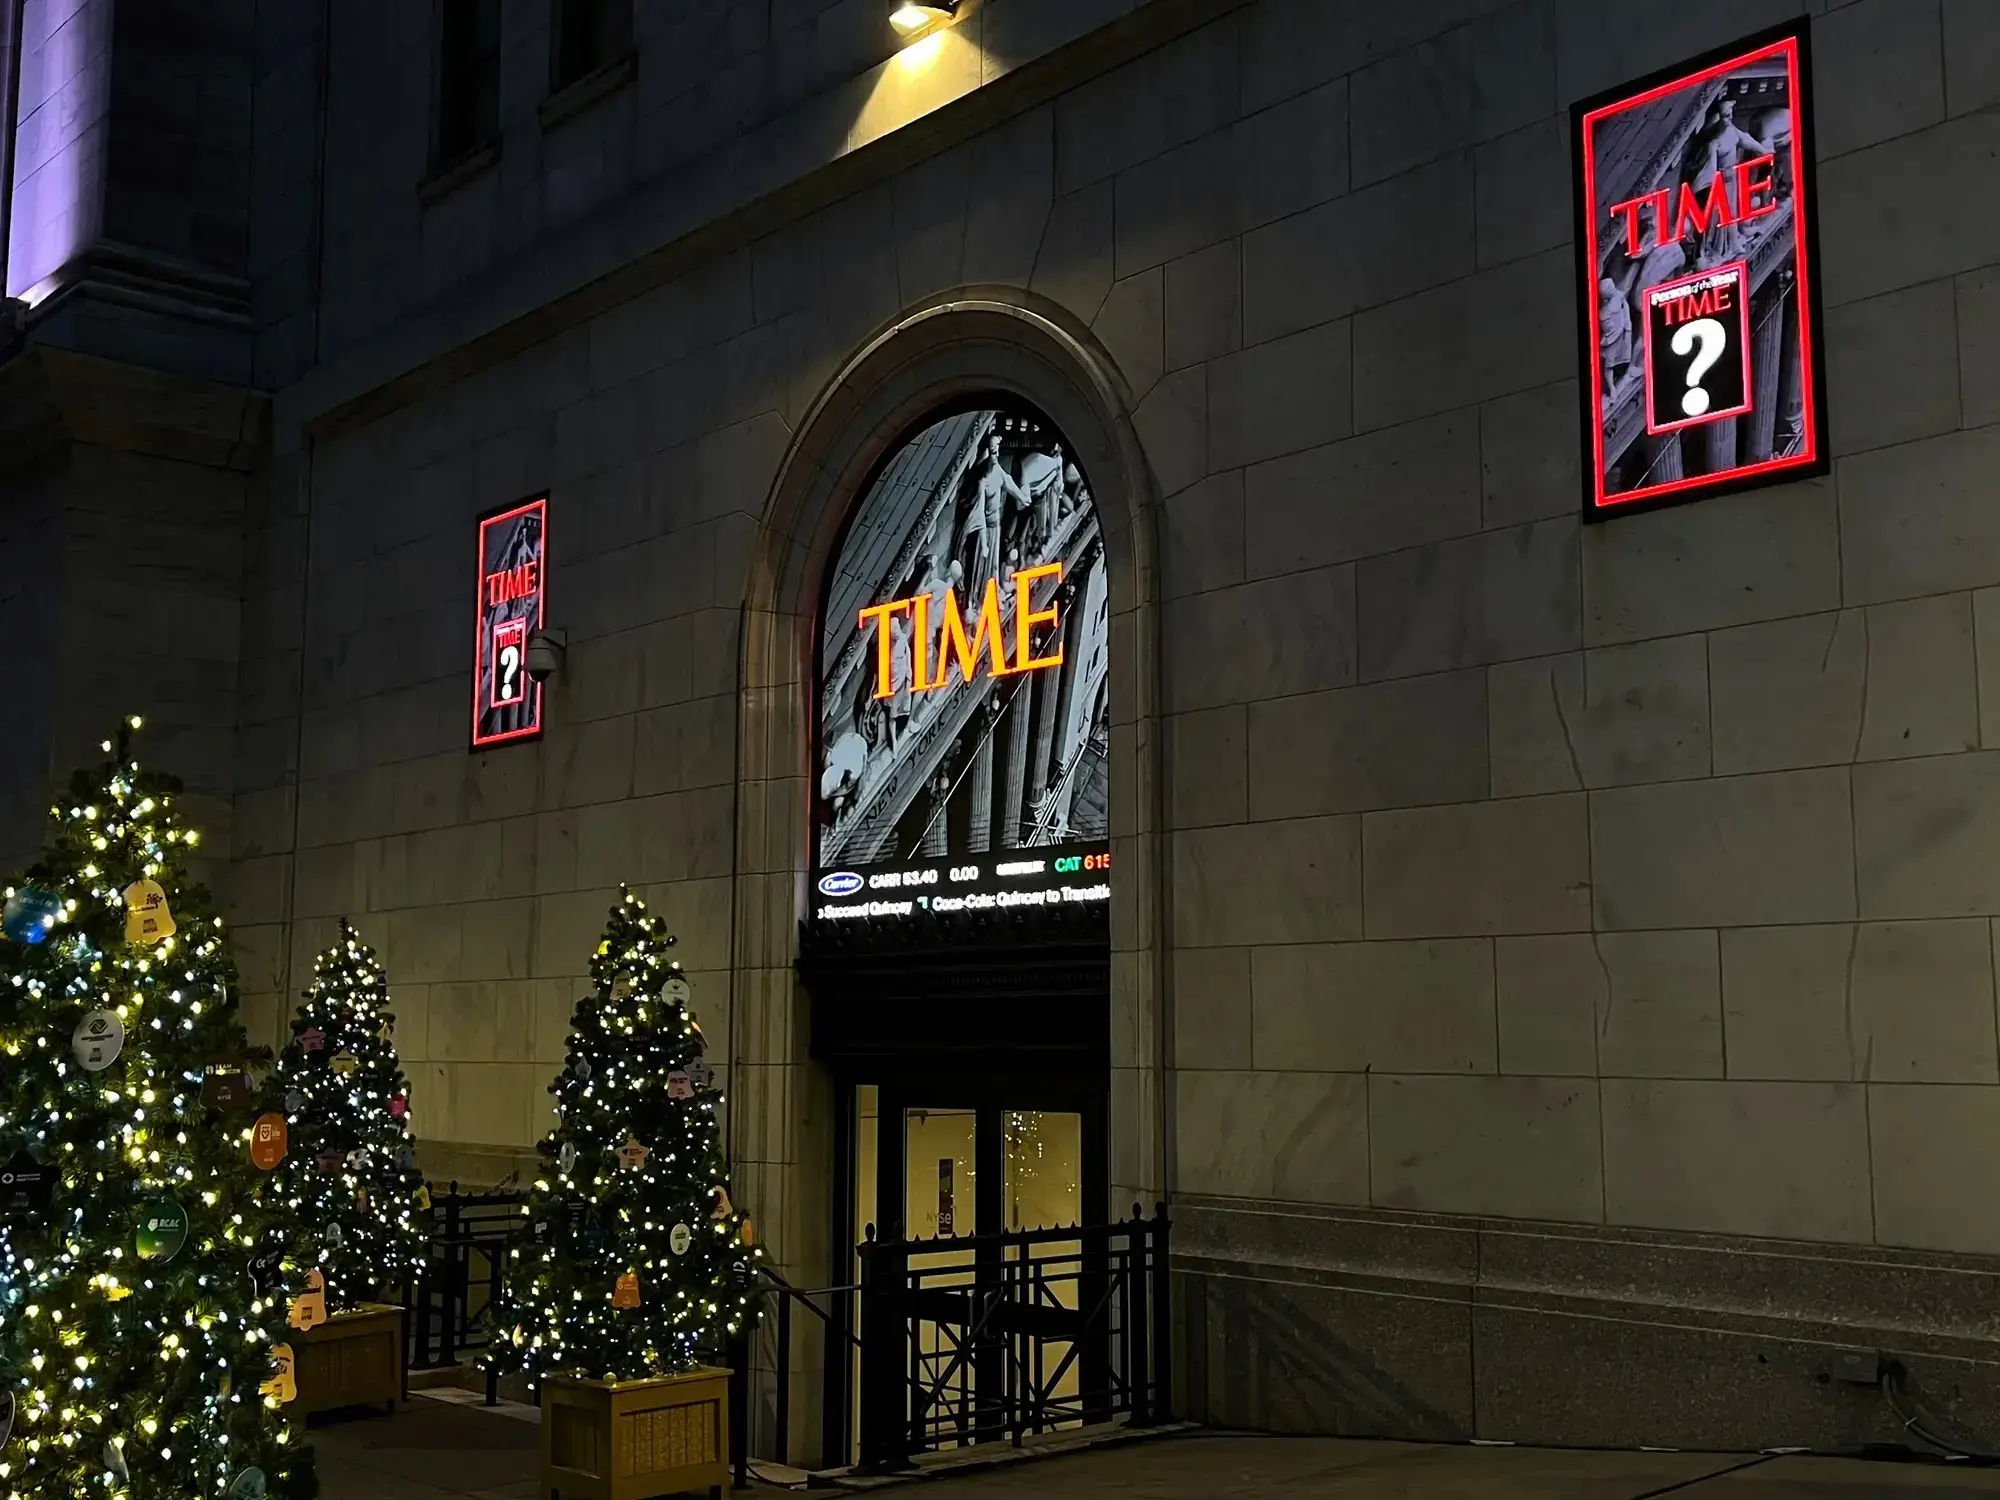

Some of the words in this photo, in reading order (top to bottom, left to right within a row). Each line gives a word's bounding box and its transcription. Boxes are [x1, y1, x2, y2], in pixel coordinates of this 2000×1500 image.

[1610, 153, 1776, 257] TIME
[1692, 282, 1700, 293] of
[1658, 283, 1732, 326] TIME
[486, 561, 537, 607] TIME
[498, 628, 521, 648] TIME
[858, 561, 1064, 700] TIME
[1054, 856, 1082, 872] CAT
[869, 872, 901, 888] CARR
[949, 865, 979, 882] 0.00
[824, 877, 860, 890] Carrier
[1046, 888, 1061, 903] to
